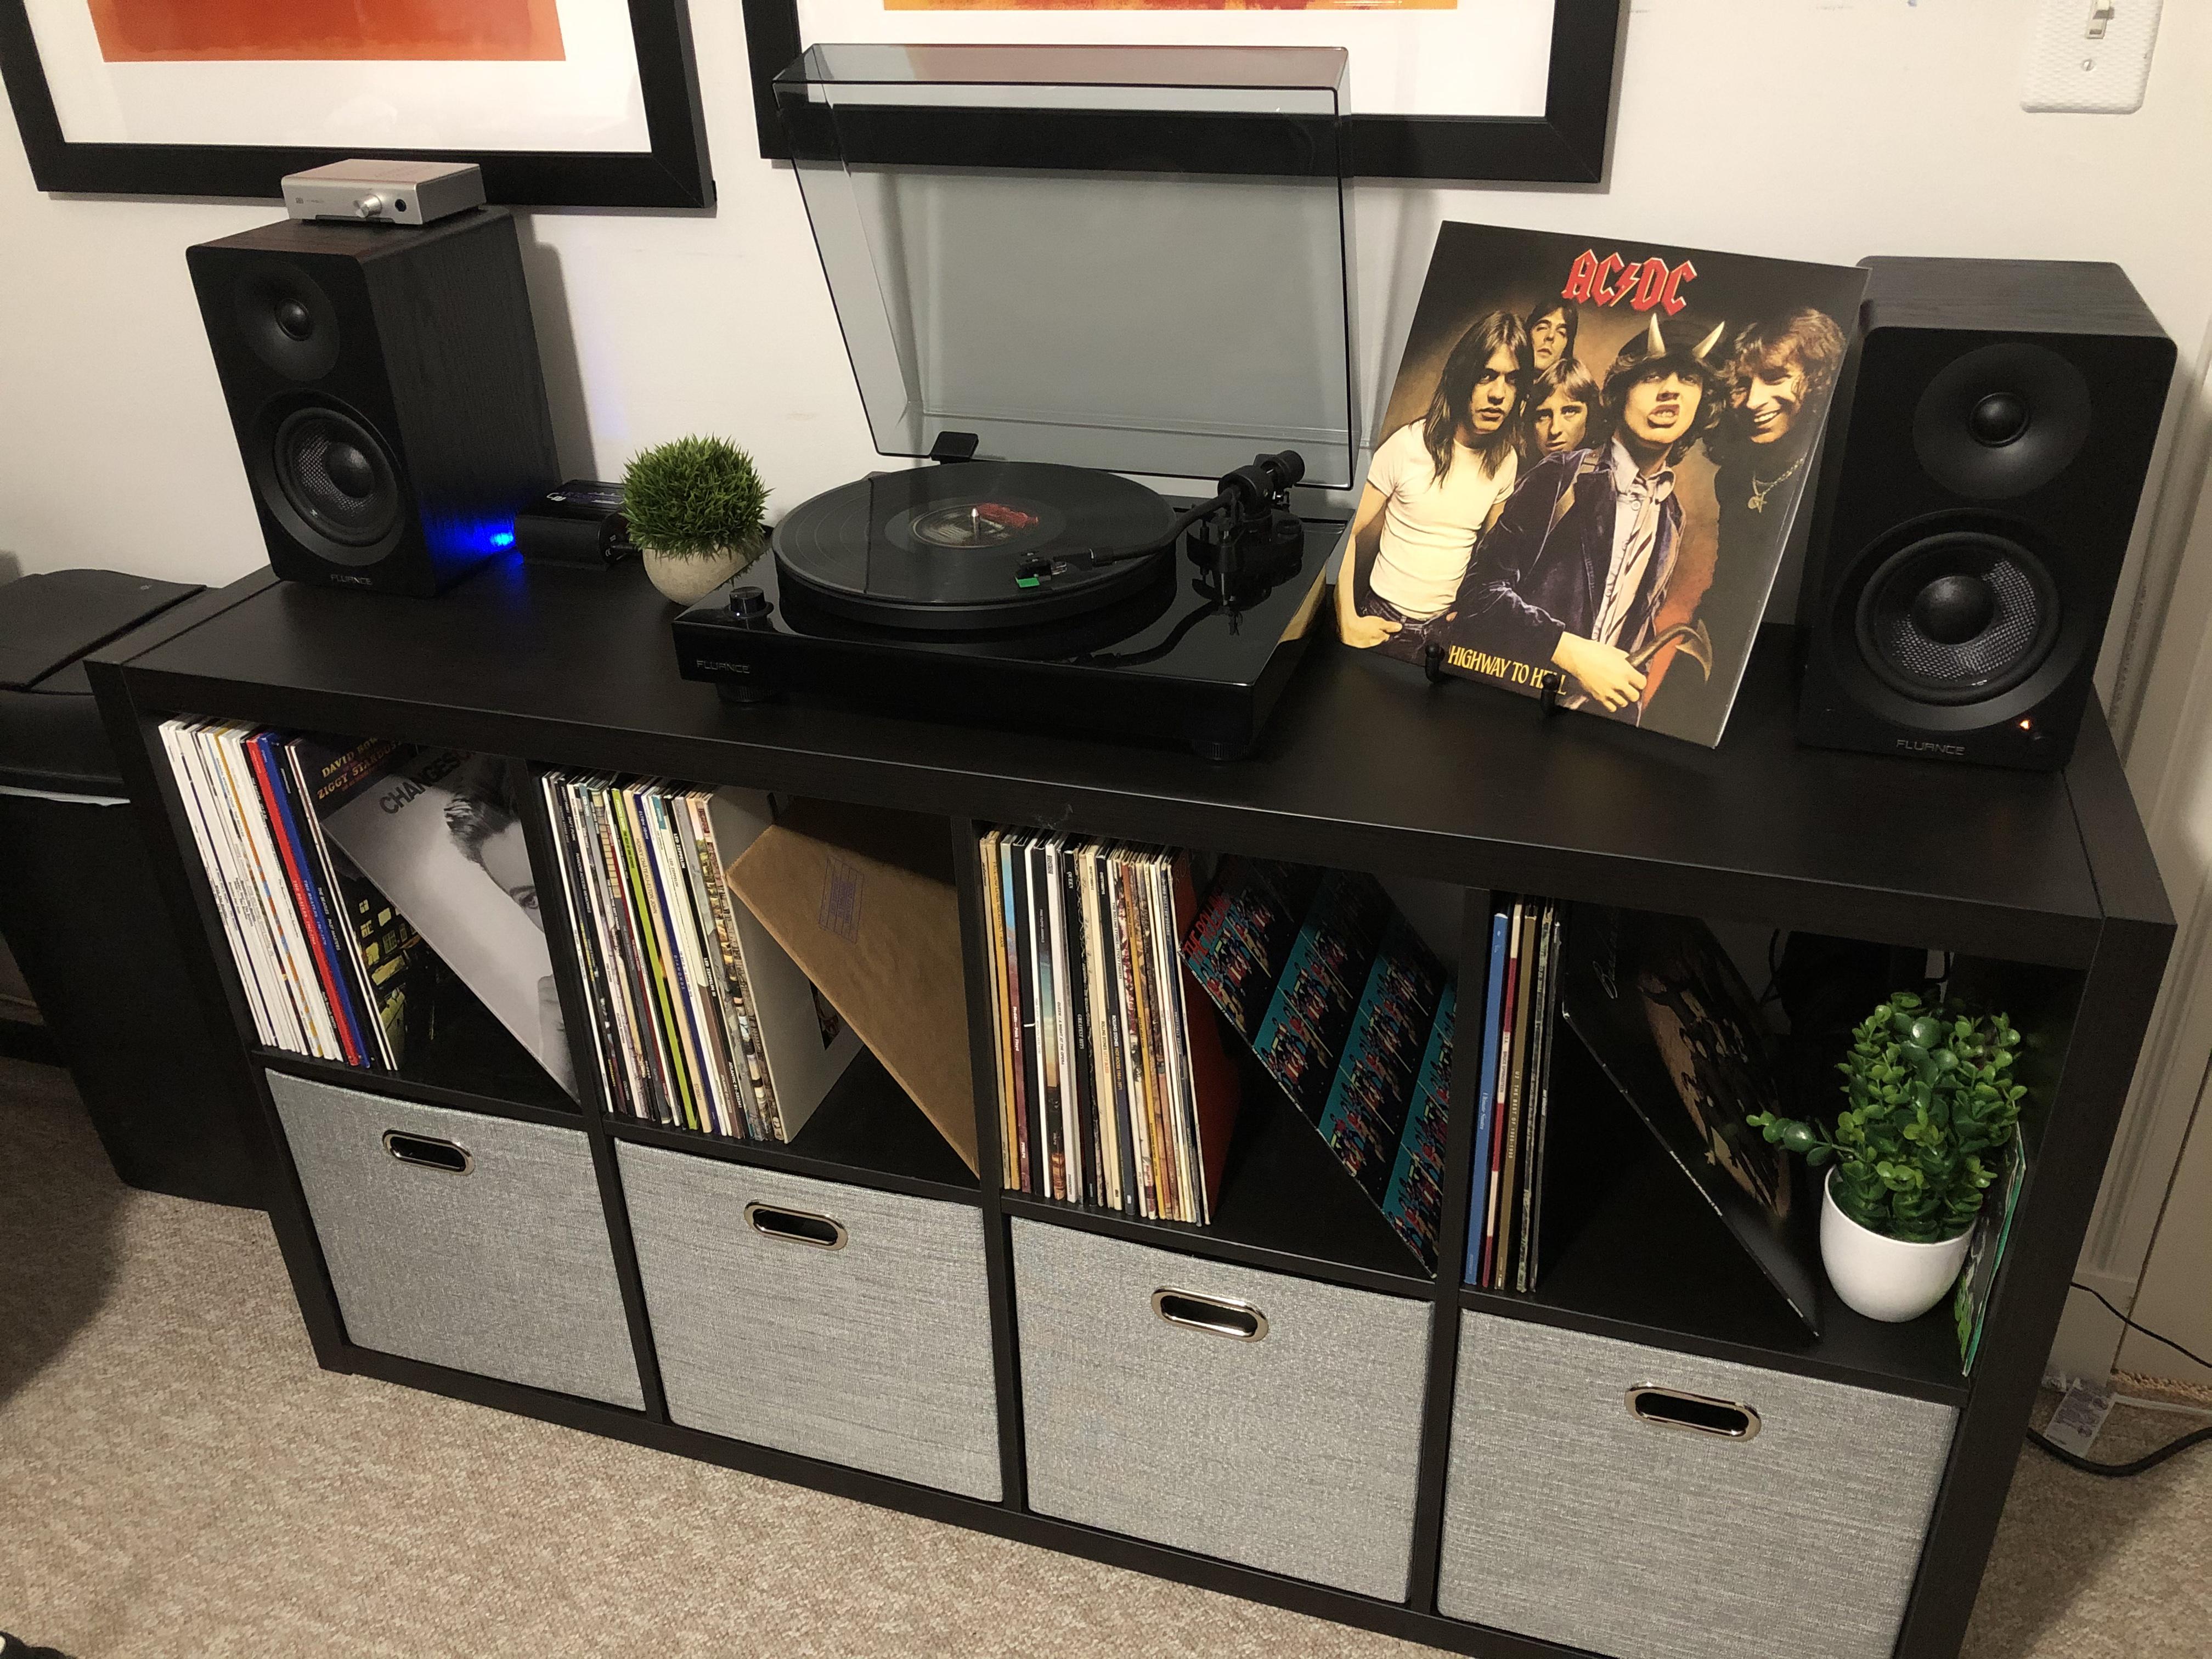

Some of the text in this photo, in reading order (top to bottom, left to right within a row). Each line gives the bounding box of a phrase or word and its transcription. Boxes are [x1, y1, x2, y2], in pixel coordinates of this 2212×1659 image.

[696, 659, 750, 674] FLUANCE
[1448, 645, 1567, 695] HIGHWAY TO HL
[1896, 740, 1965, 755] FLUANCE
[321, 751, 355, 778] DAVID
[317, 774, 348, 800] ZIGGY
[635, 838, 645, 856] HONKY
[675, 844, 685, 869] ZEPPELIN
[670, 867, 679, 887] ZEPPELIN
[292, 879, 300, 891] THE
[296, 893, 308, 918] BEATLES
[307, 892, 319, 918] BEATLES
[583, 890, 591, 913] MEMORIES
[319, 896, 330, 915] BEATLES
[330, 929, 341, 951] MASTERS
[706, 968, 715, 991] ZEPPELIN
[727, 1062, 736, 1084] ATLANTIC
